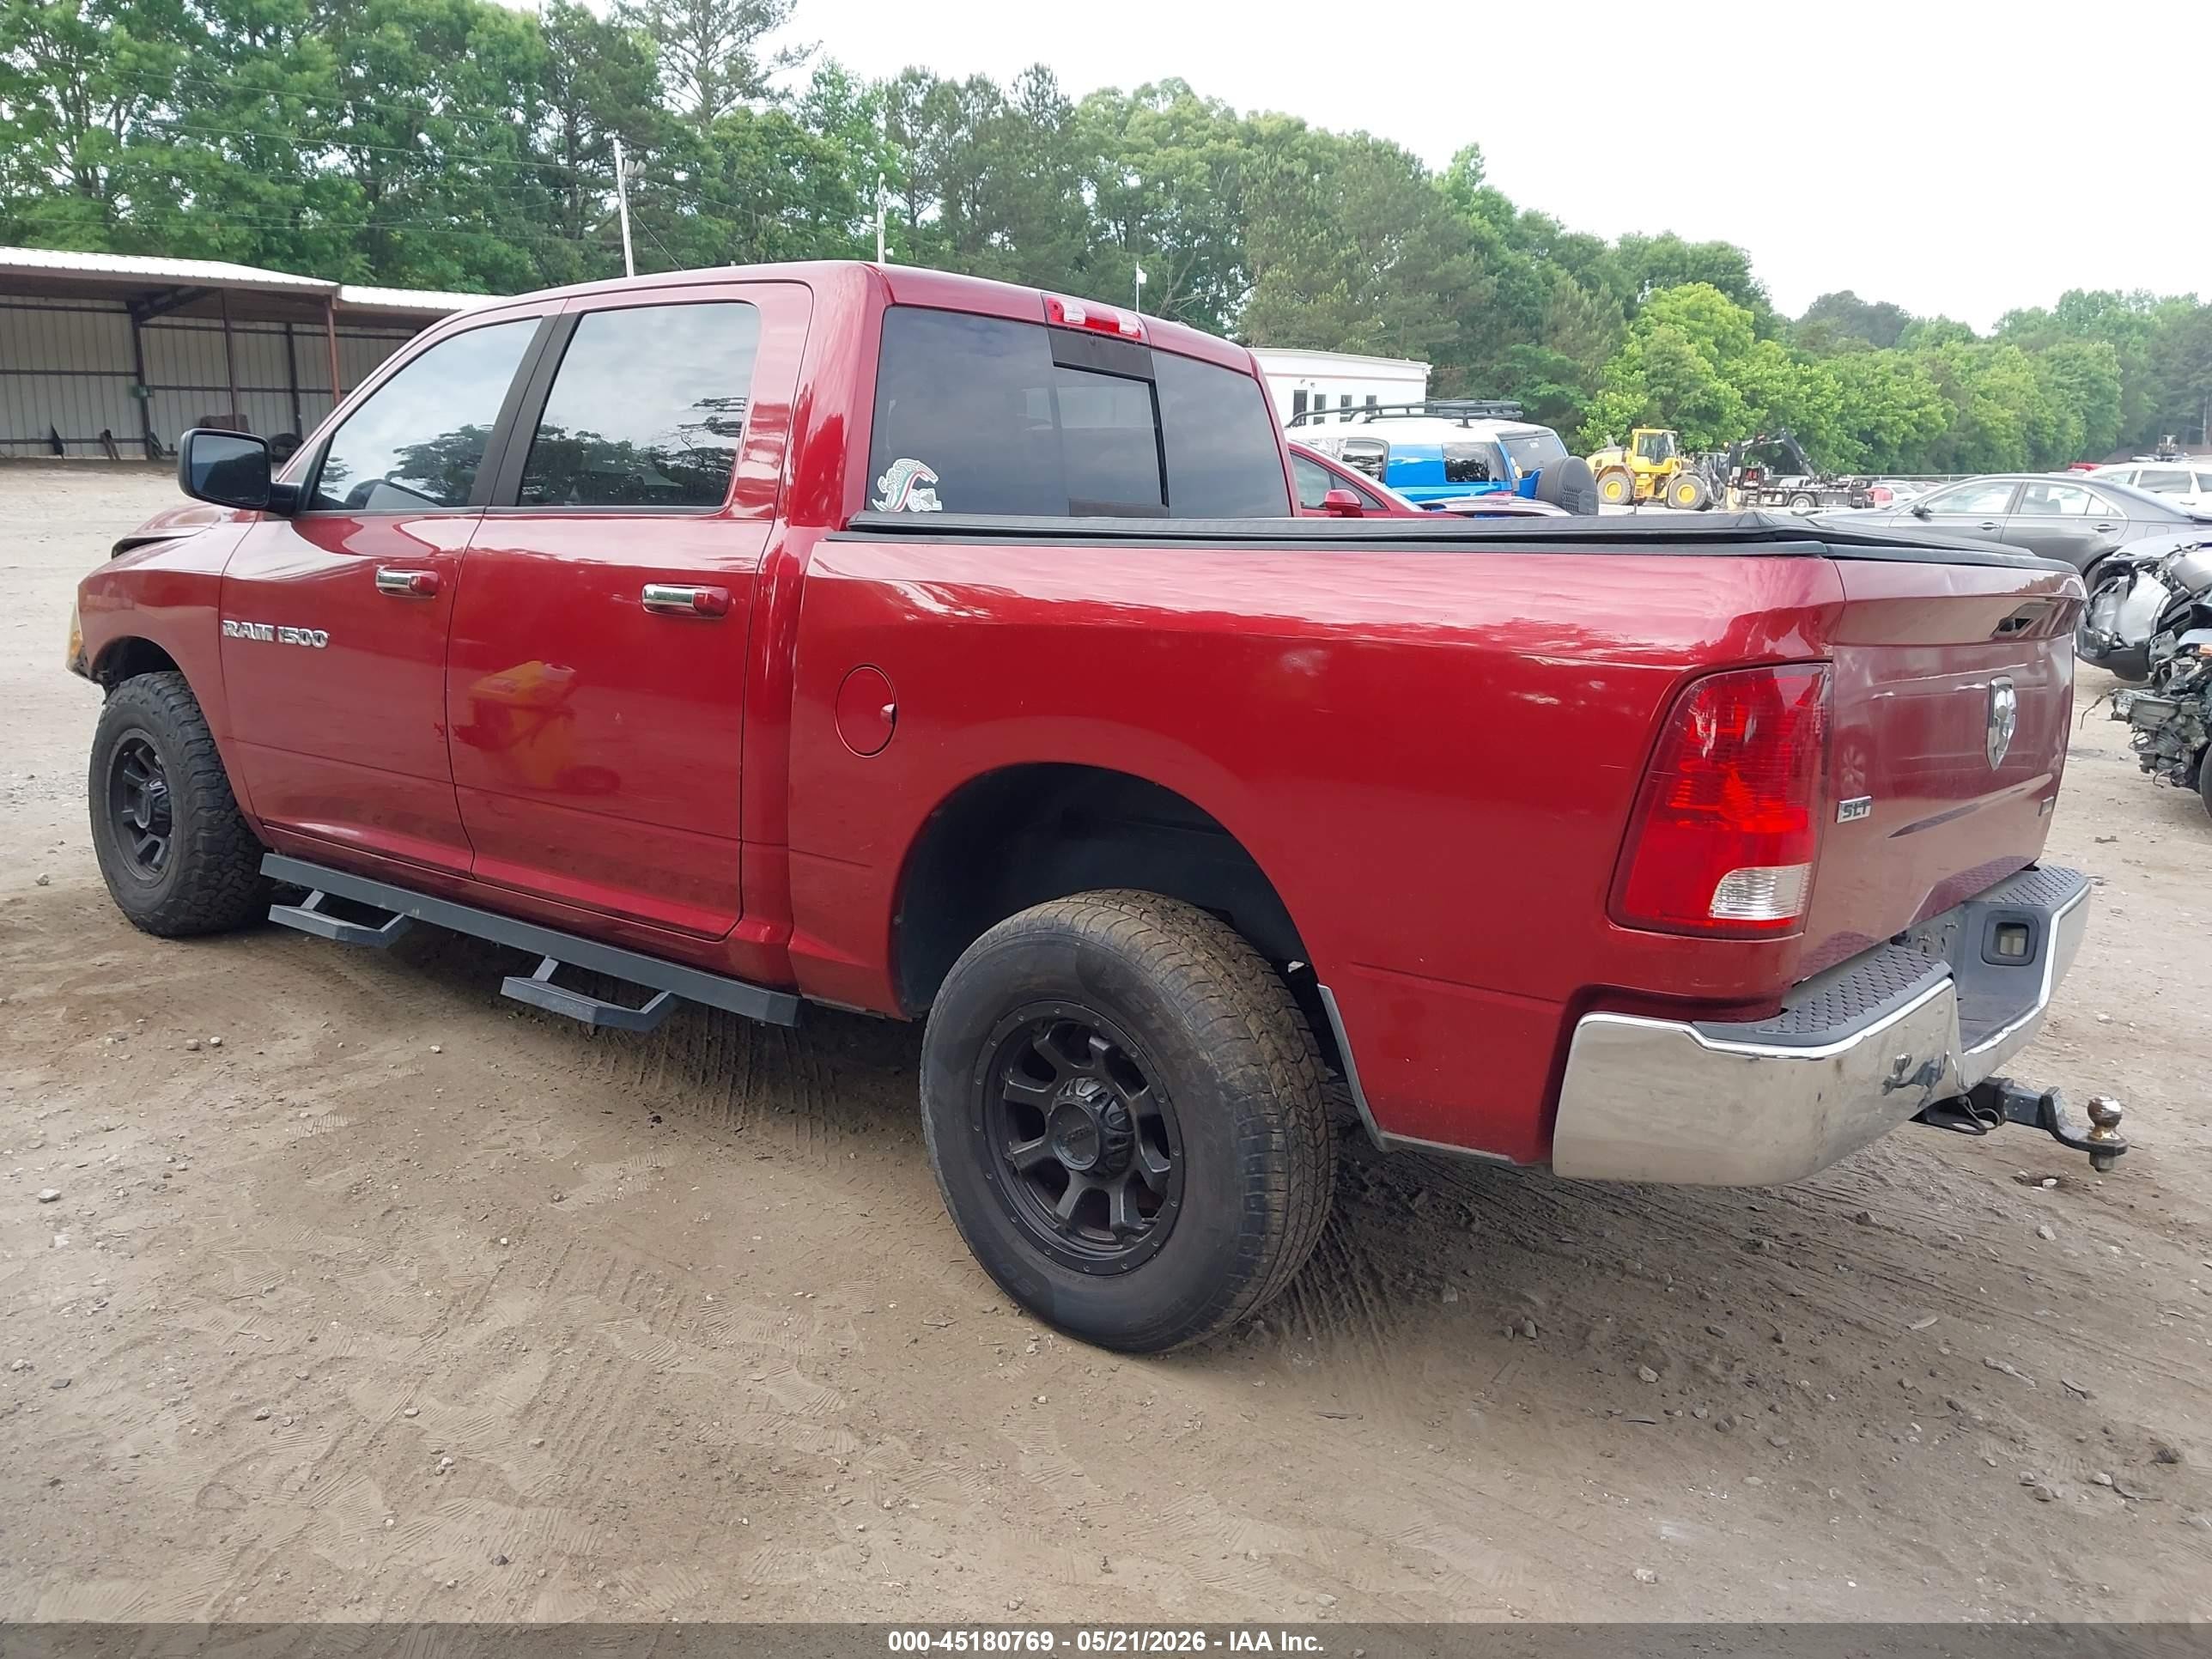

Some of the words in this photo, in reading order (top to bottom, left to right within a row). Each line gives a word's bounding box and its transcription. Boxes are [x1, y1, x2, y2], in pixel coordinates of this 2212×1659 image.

[222, 619, 274, 642] RAM
[276, 625, 330, 648] 1500
[1839, 799, 1871, 819] SLT
